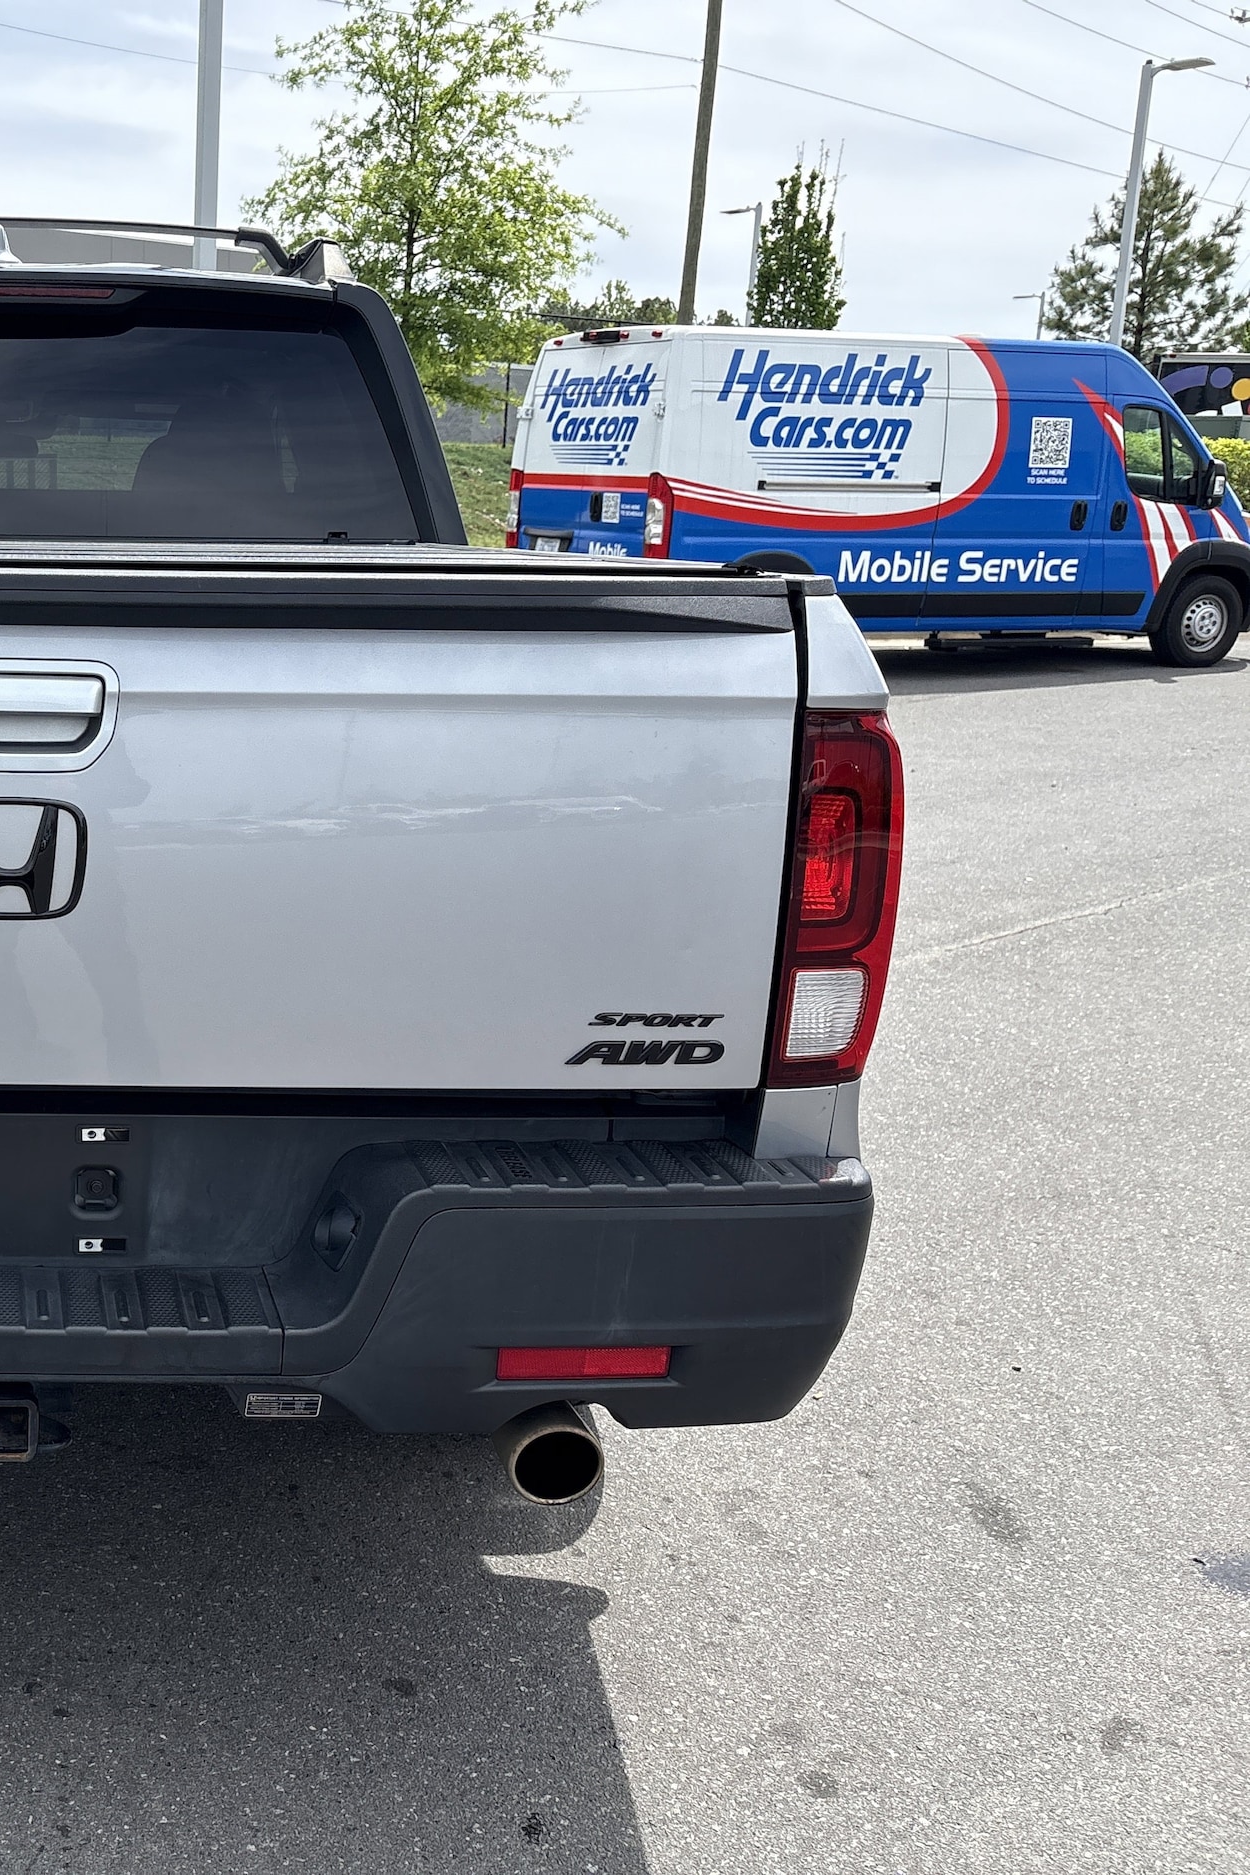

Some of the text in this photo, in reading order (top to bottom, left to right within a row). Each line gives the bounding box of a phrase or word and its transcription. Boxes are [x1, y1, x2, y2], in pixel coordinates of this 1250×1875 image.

[540, 363, 657, 423] Hendrick
[717, 348, 932, 421] Hendrick
[552, 411, 639, 442] Cars.com
[749, 406, 913, 450] Cars.com
[1036, 477, 1068, 485] SCHEDULE
[837, 550, 1079, 583] Mobile Service
[588, 1012, 725, 1028] SPORT
[563, 1040, 725, 1065] AWD
